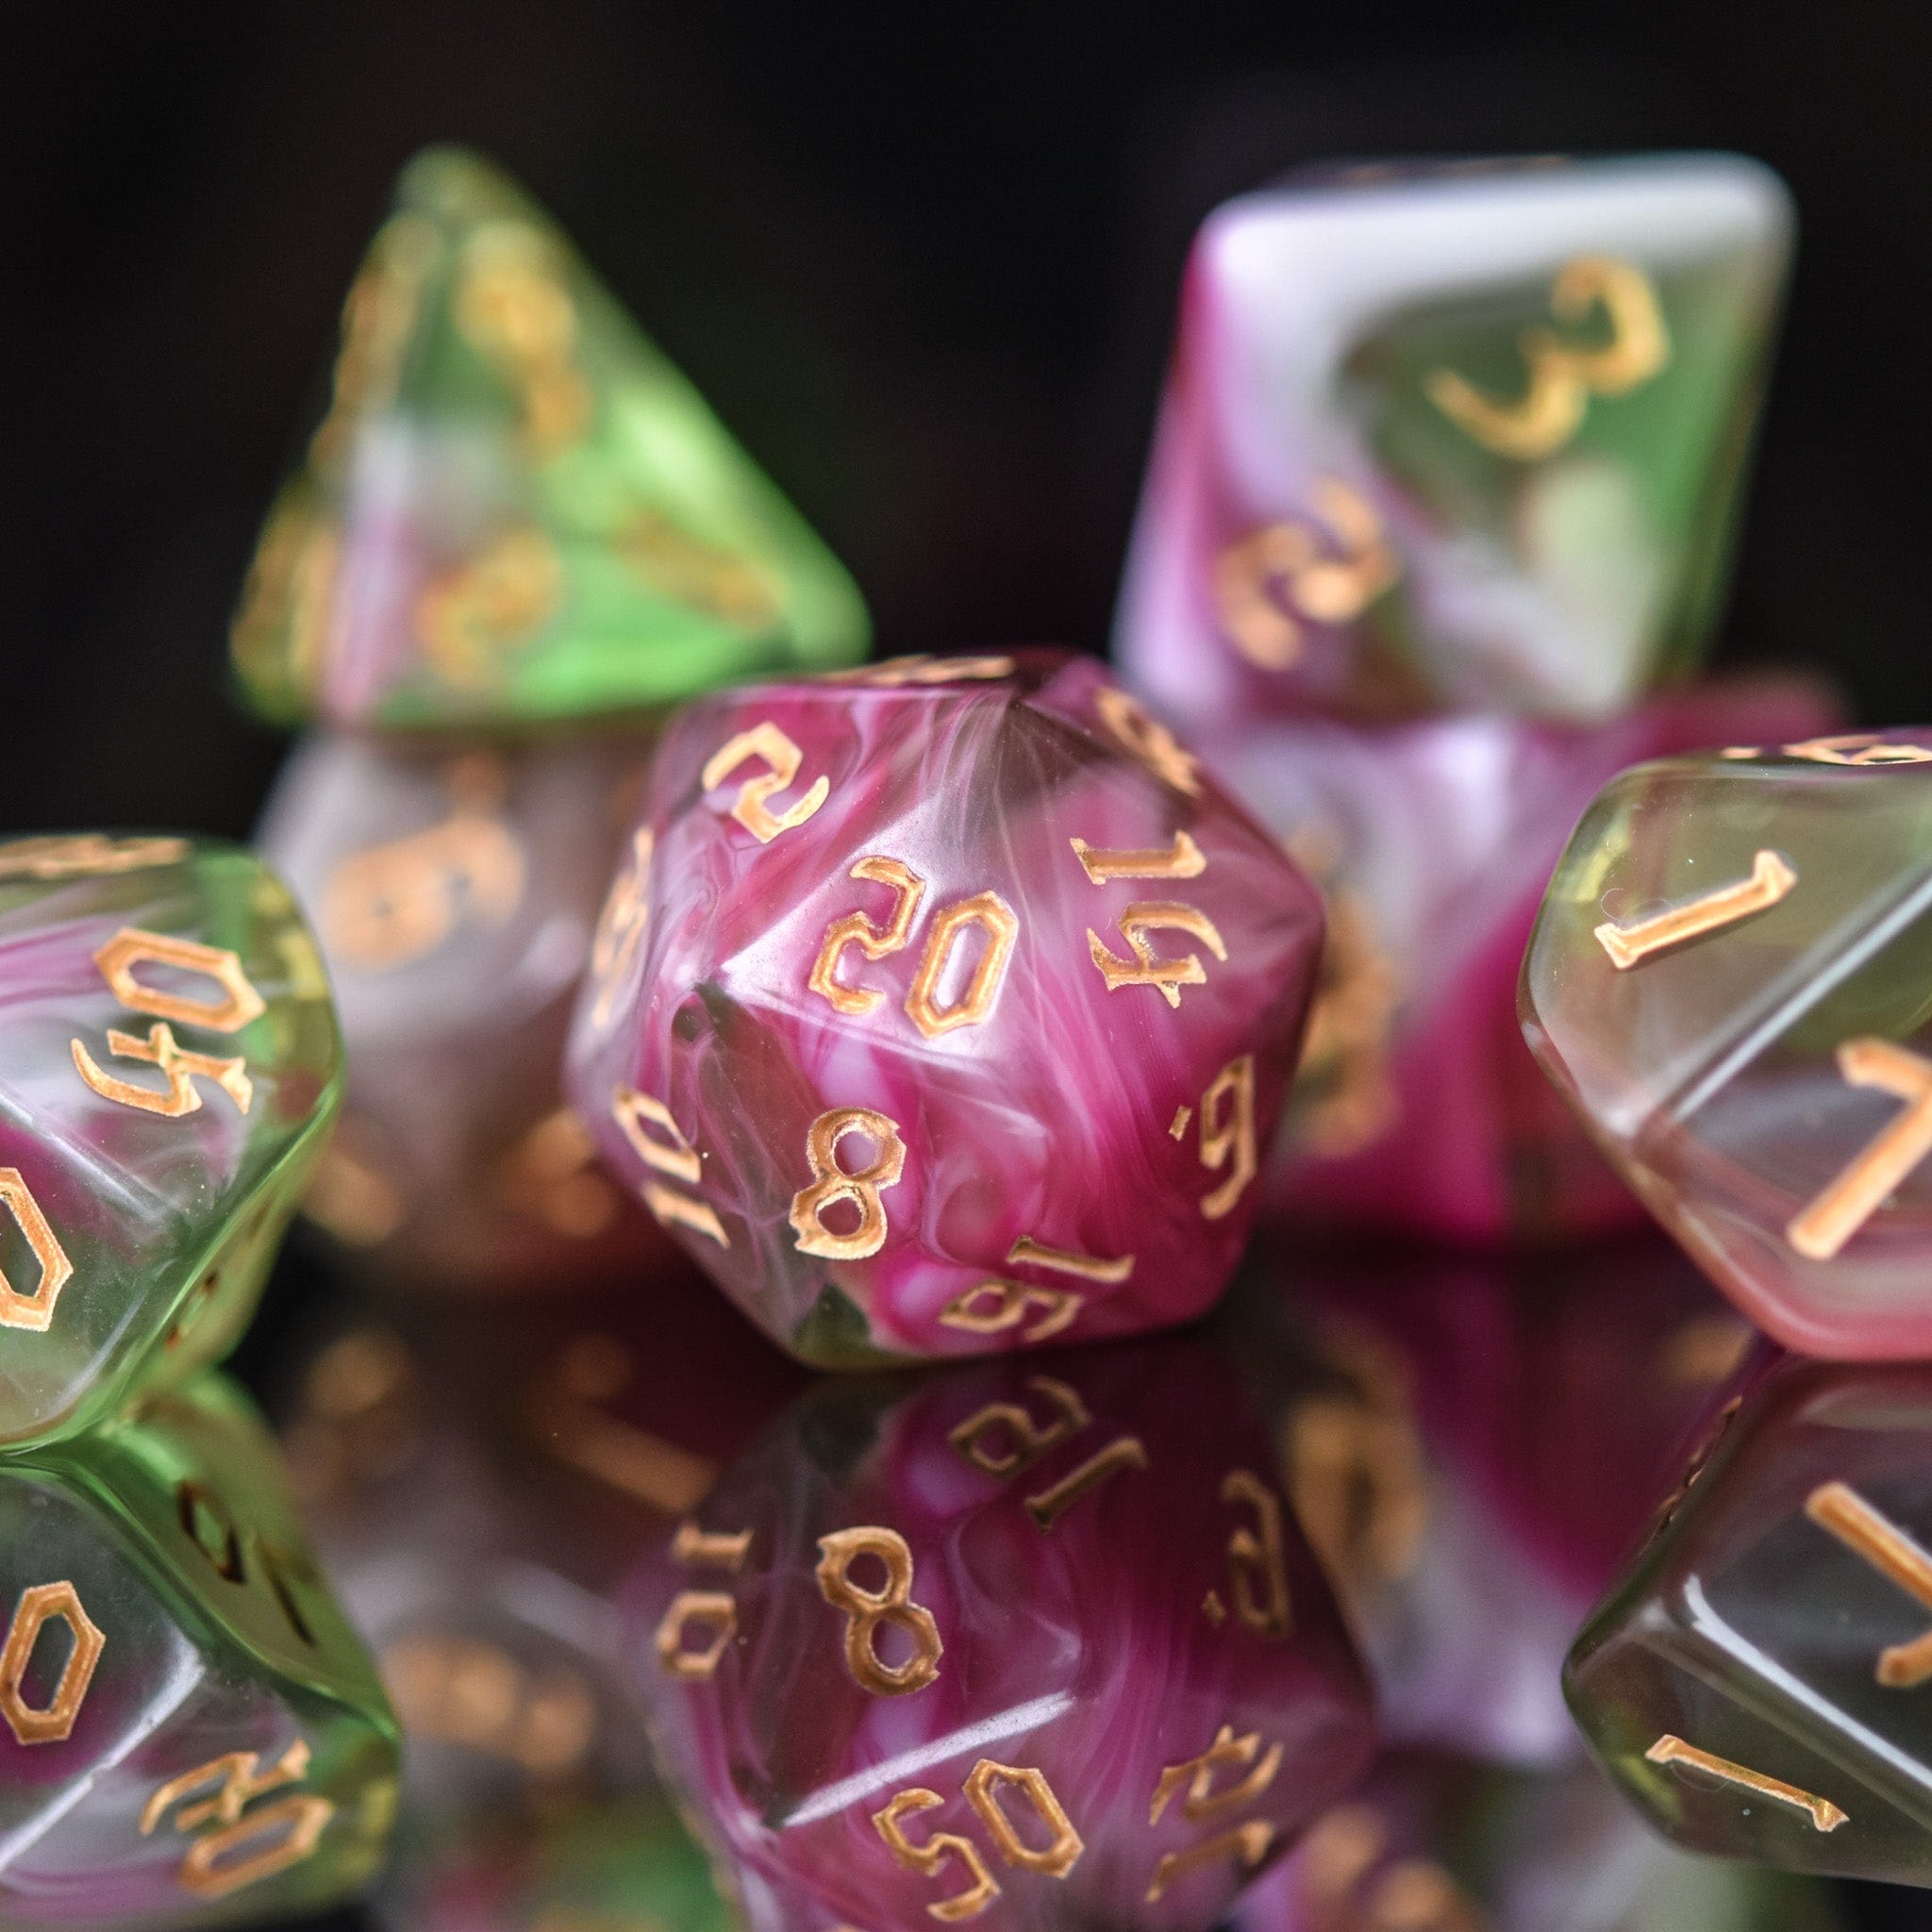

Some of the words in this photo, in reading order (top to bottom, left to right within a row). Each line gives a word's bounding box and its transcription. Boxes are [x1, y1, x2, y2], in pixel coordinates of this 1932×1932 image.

[1423, 255, 1668, 459] 3
[808, 855, 1020, 1039] 20
[1594, 850, 1798, 970] 1
[611, 1081, 730, 1249] 10
[789, 1106, 907, 1260] 8
